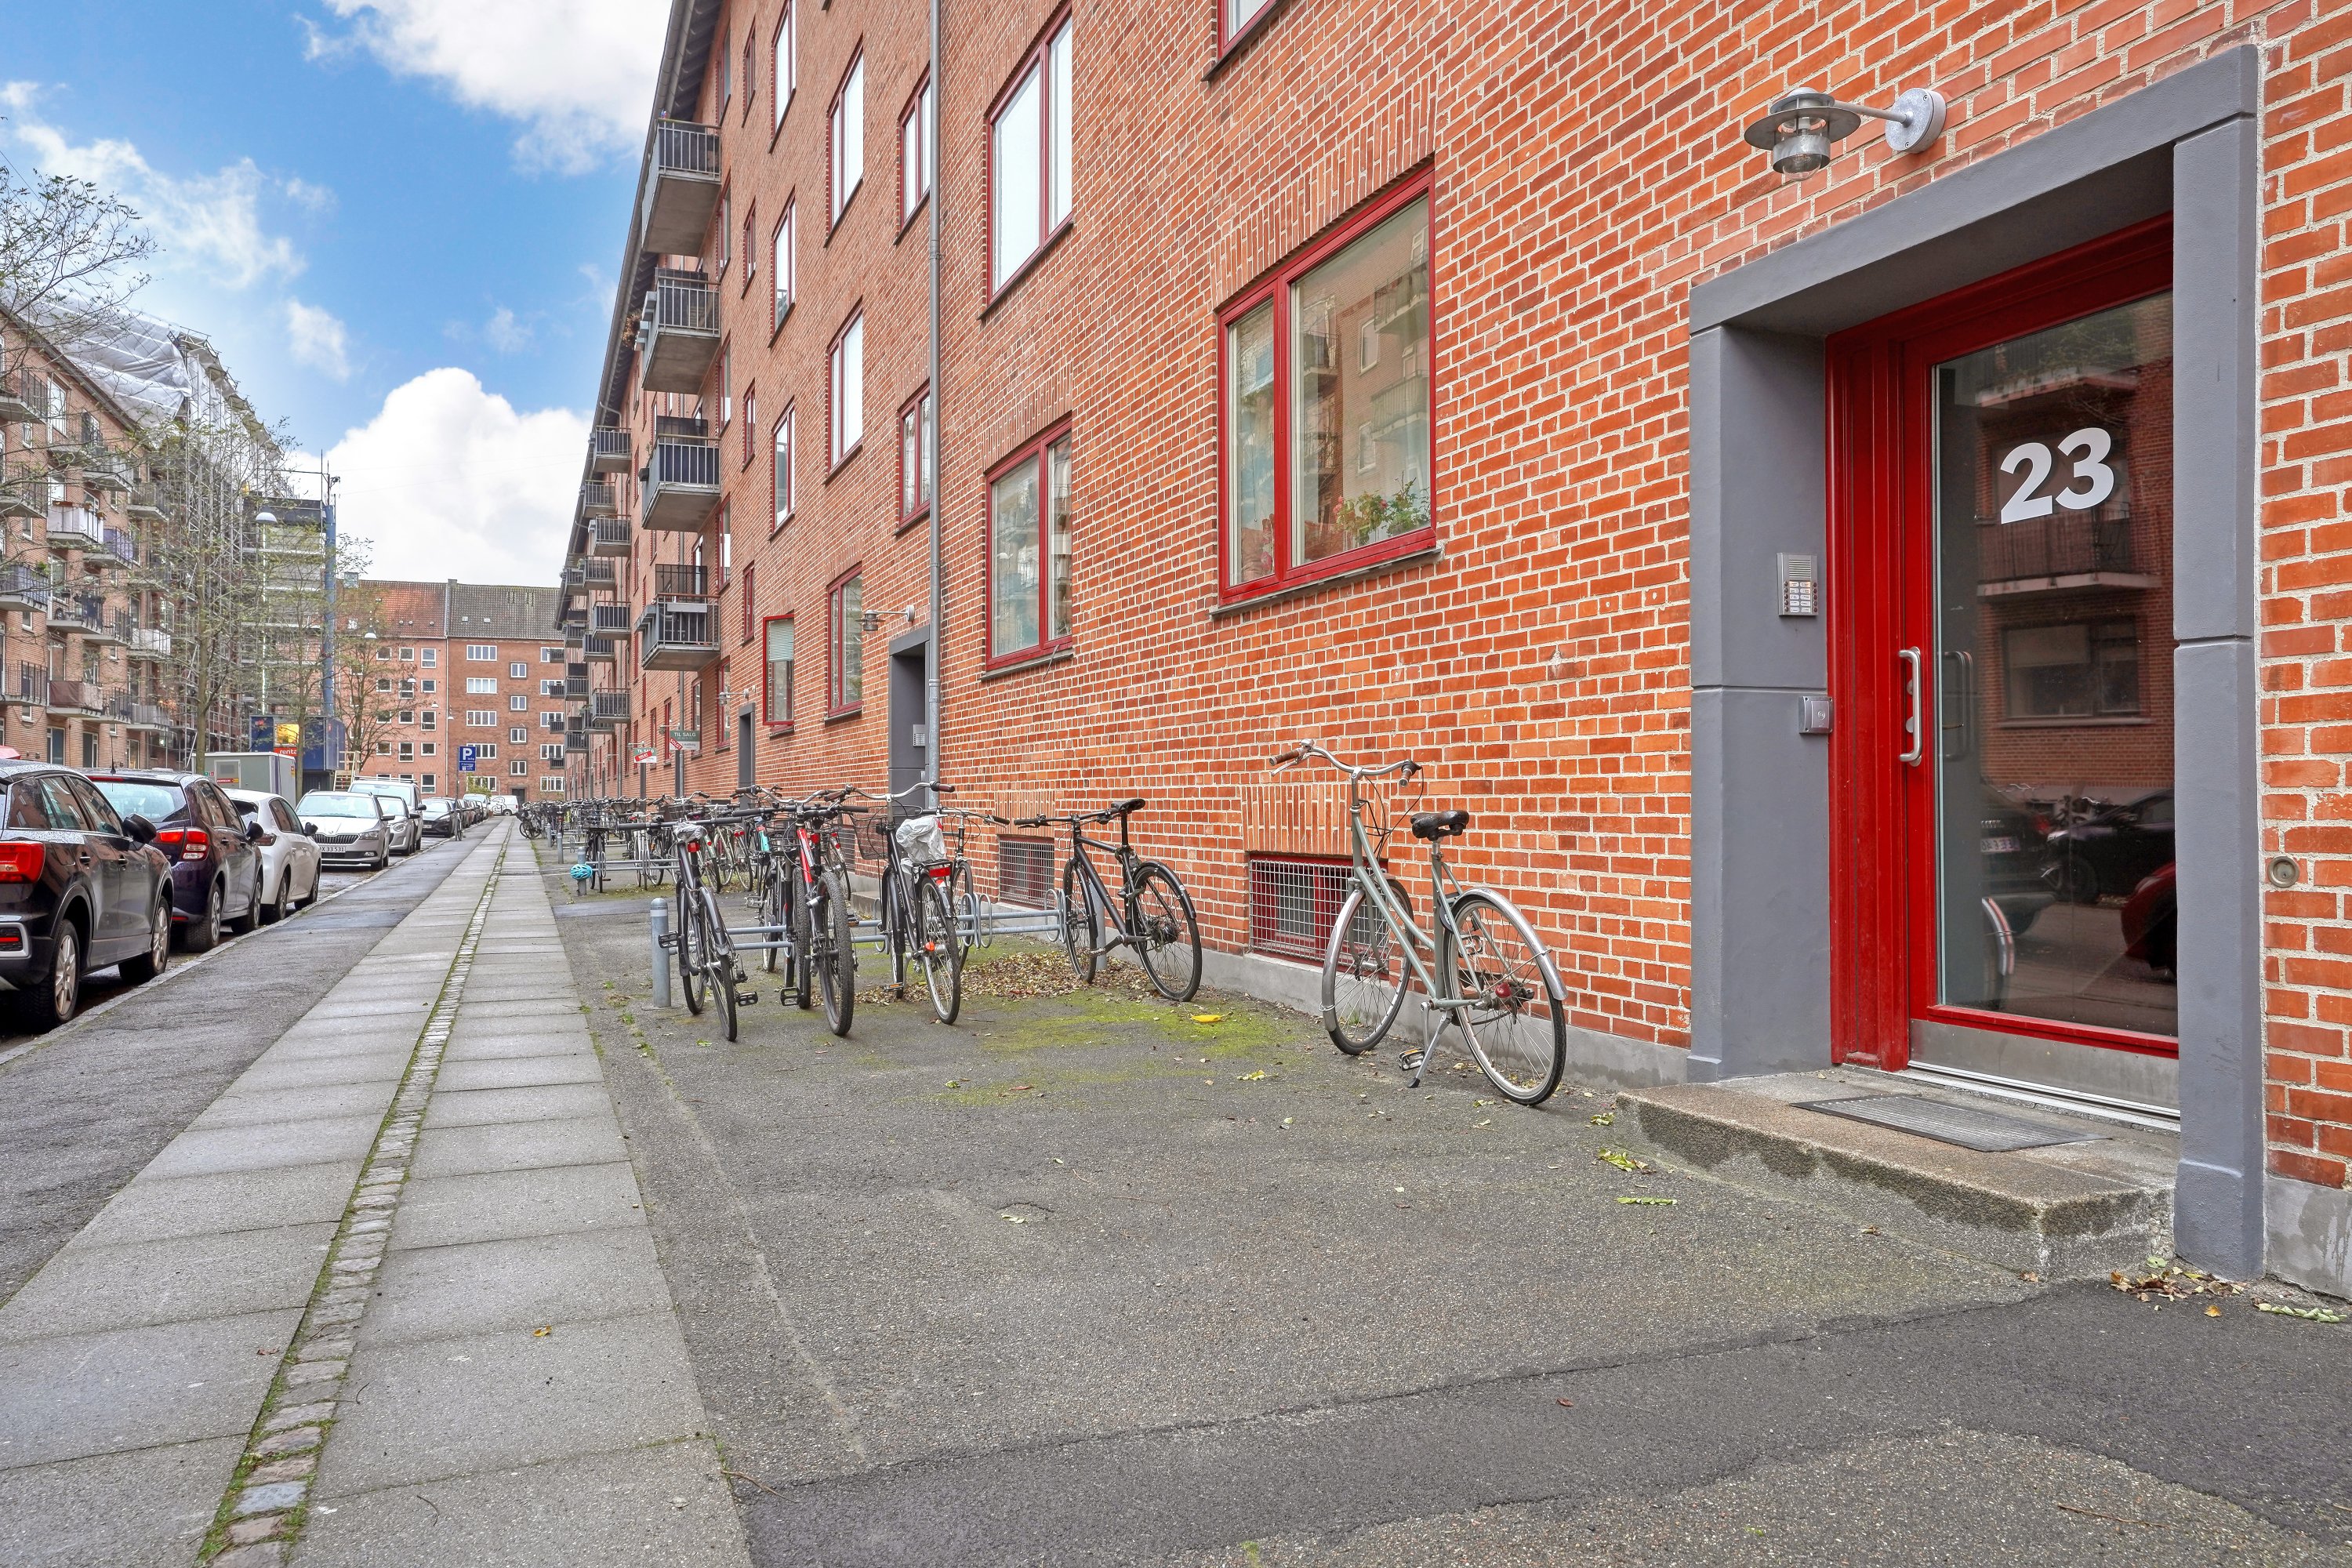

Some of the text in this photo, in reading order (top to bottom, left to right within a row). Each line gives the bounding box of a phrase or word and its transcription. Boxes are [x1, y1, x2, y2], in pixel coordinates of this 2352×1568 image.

[2000, 427, 2114, 524] 23
[670, 738, 682, 750] SOLGT
[463, 748, 473, 760] P
